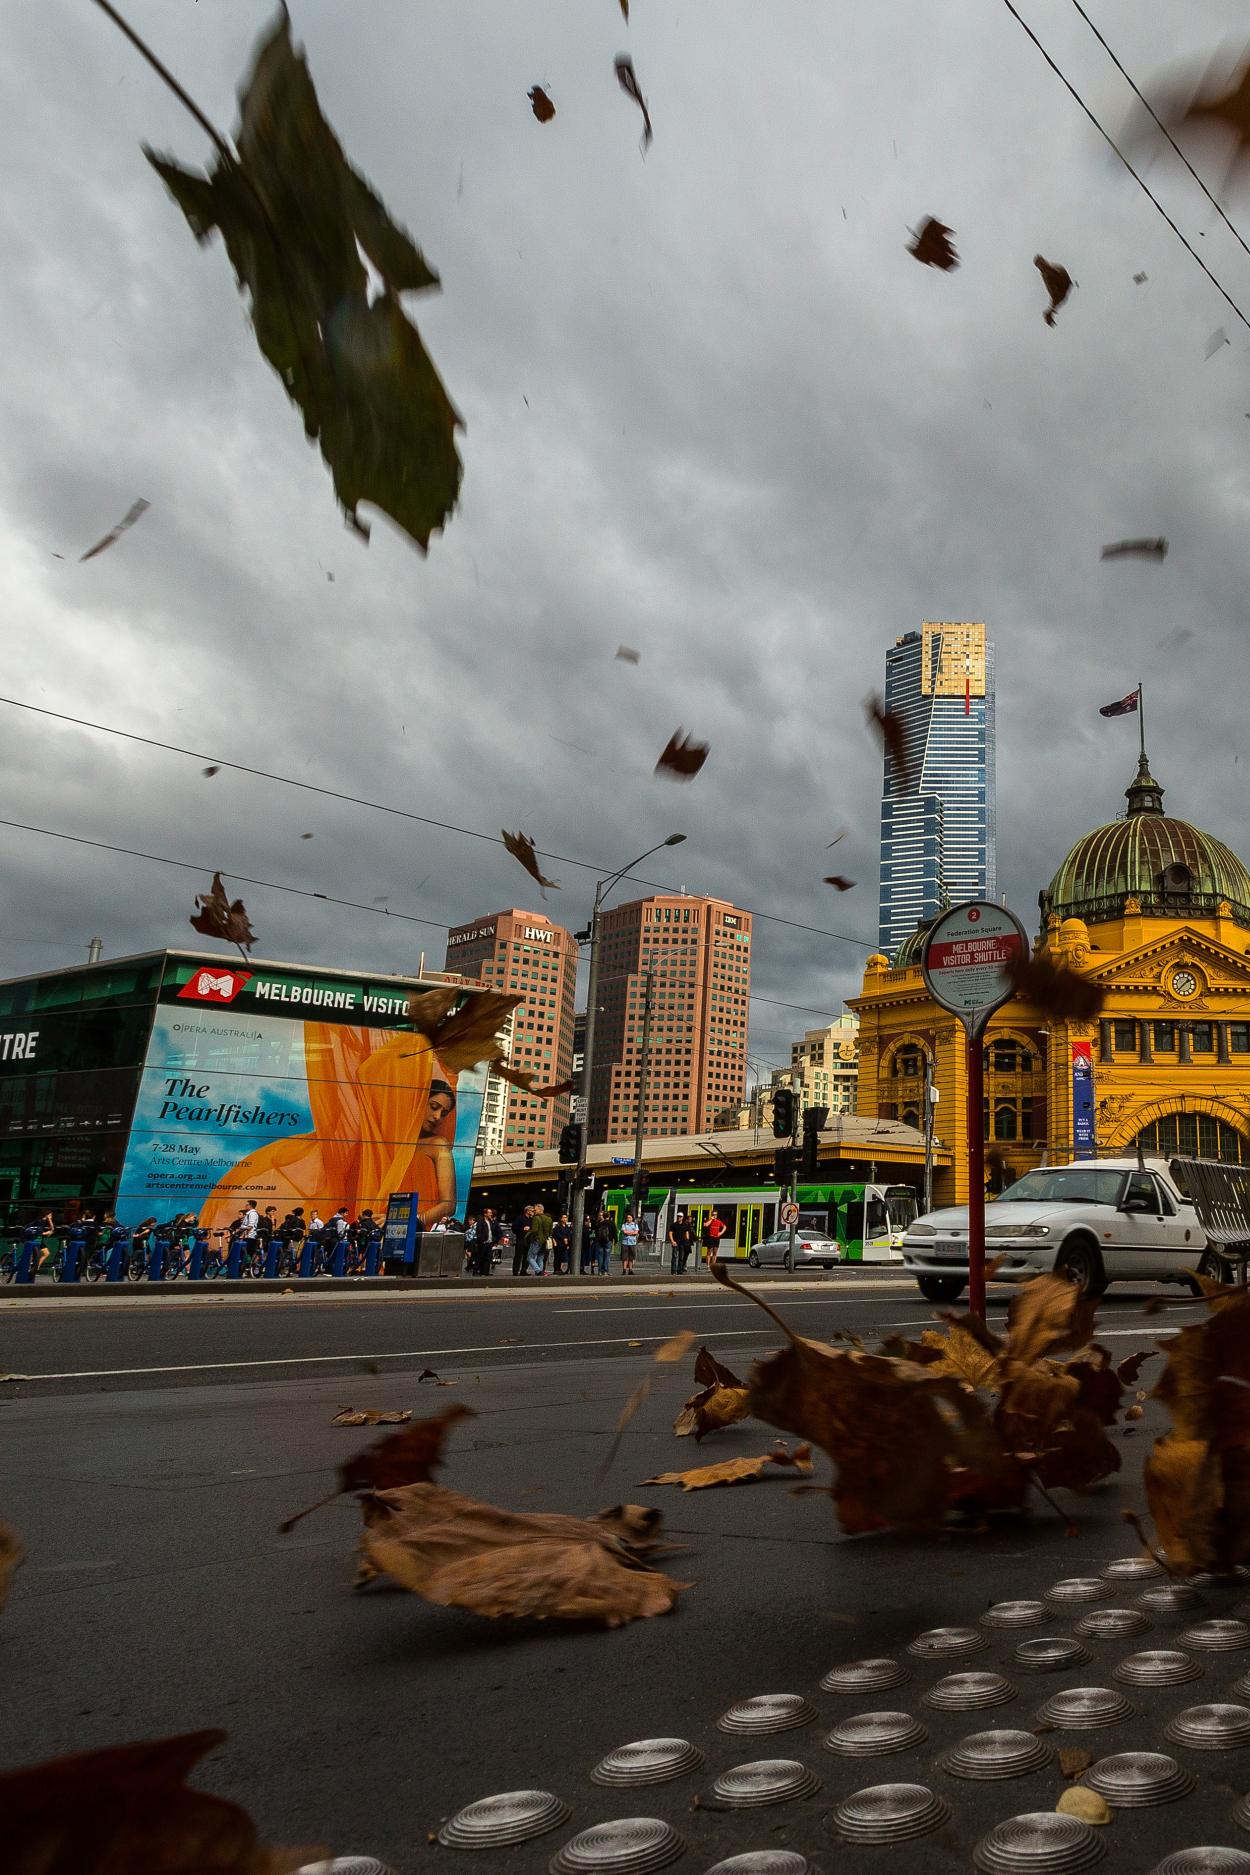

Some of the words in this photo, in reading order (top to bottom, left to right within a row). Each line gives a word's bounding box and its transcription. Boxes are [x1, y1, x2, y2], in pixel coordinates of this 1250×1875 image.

[447, 930, 477, 946] HERALD
[479, 925, 495, 938] SUN
[524, 926, 554, 943] HWT
[947, 928, 980, 936] Federation
[952, 940, 997, 954] MELBOURNE
[943, 954, 970, 966] VISITOR
[974, 950, 1006, 962] SHUTTLE
[255, 982, 356, 1010] MELBOURNE
[363, 995, 410, 1016] VISITO
[0, 1031, 40, 1060] TRE
[165, 1078, 210, 1099] The
[157, 1101, 300, 1127] Pearlfishers
[152, 1143, 176, 1153] 7-28
[178, 1144, 200, 1156] May
[150, 1156, 171, 1166] Arts
[172, 1157, 203, 1167] Centre
[204, 1158, 252, 1168] Melbourne
[147, 1172, 208, 1182] opera.org.au
[145, 1182, 277, 1191] artscentremelbourne.com.au
